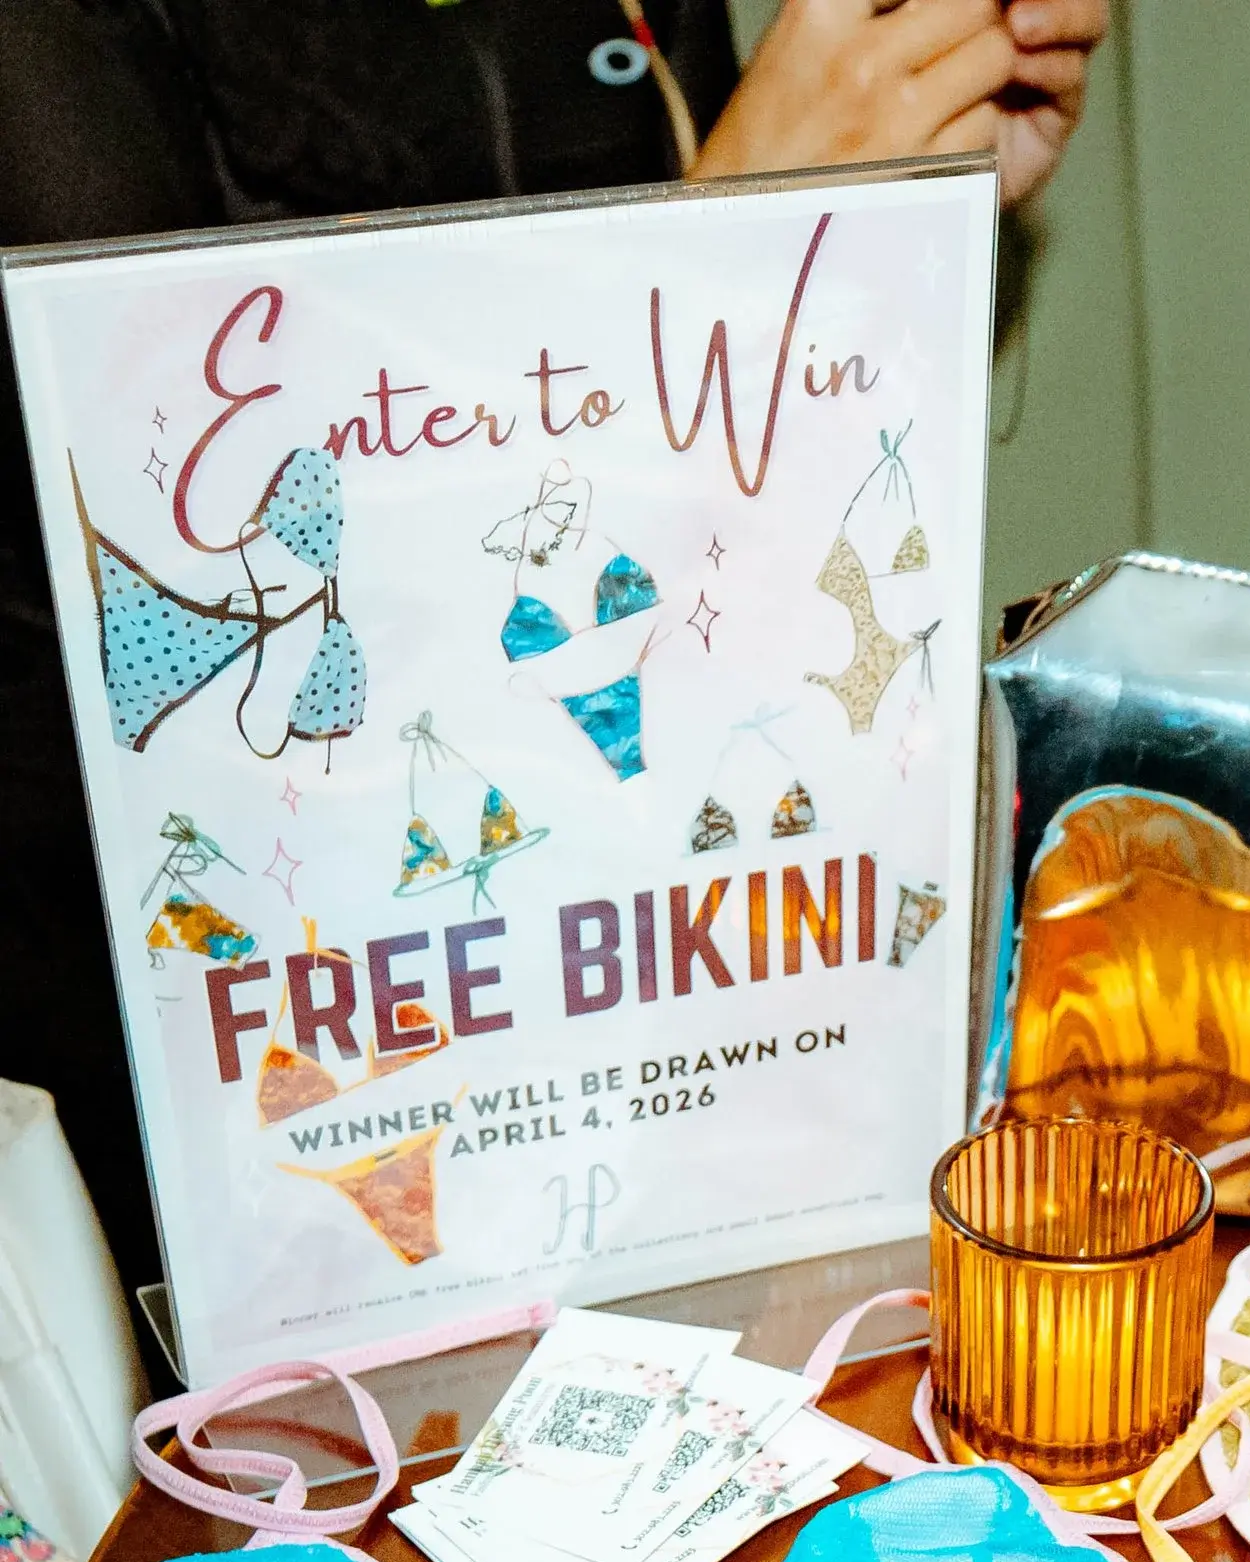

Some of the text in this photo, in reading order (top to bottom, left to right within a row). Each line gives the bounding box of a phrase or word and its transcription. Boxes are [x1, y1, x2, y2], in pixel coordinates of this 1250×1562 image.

[172, 212, 880, 553] Enter to Win
[205, 852, 876, 1083] FREE BIKINI
[289, 1024, 846, 1154] WINNER WILL BE DRAWN ON
[450, 1083, 716, 1158] APRIL 4, 2026
